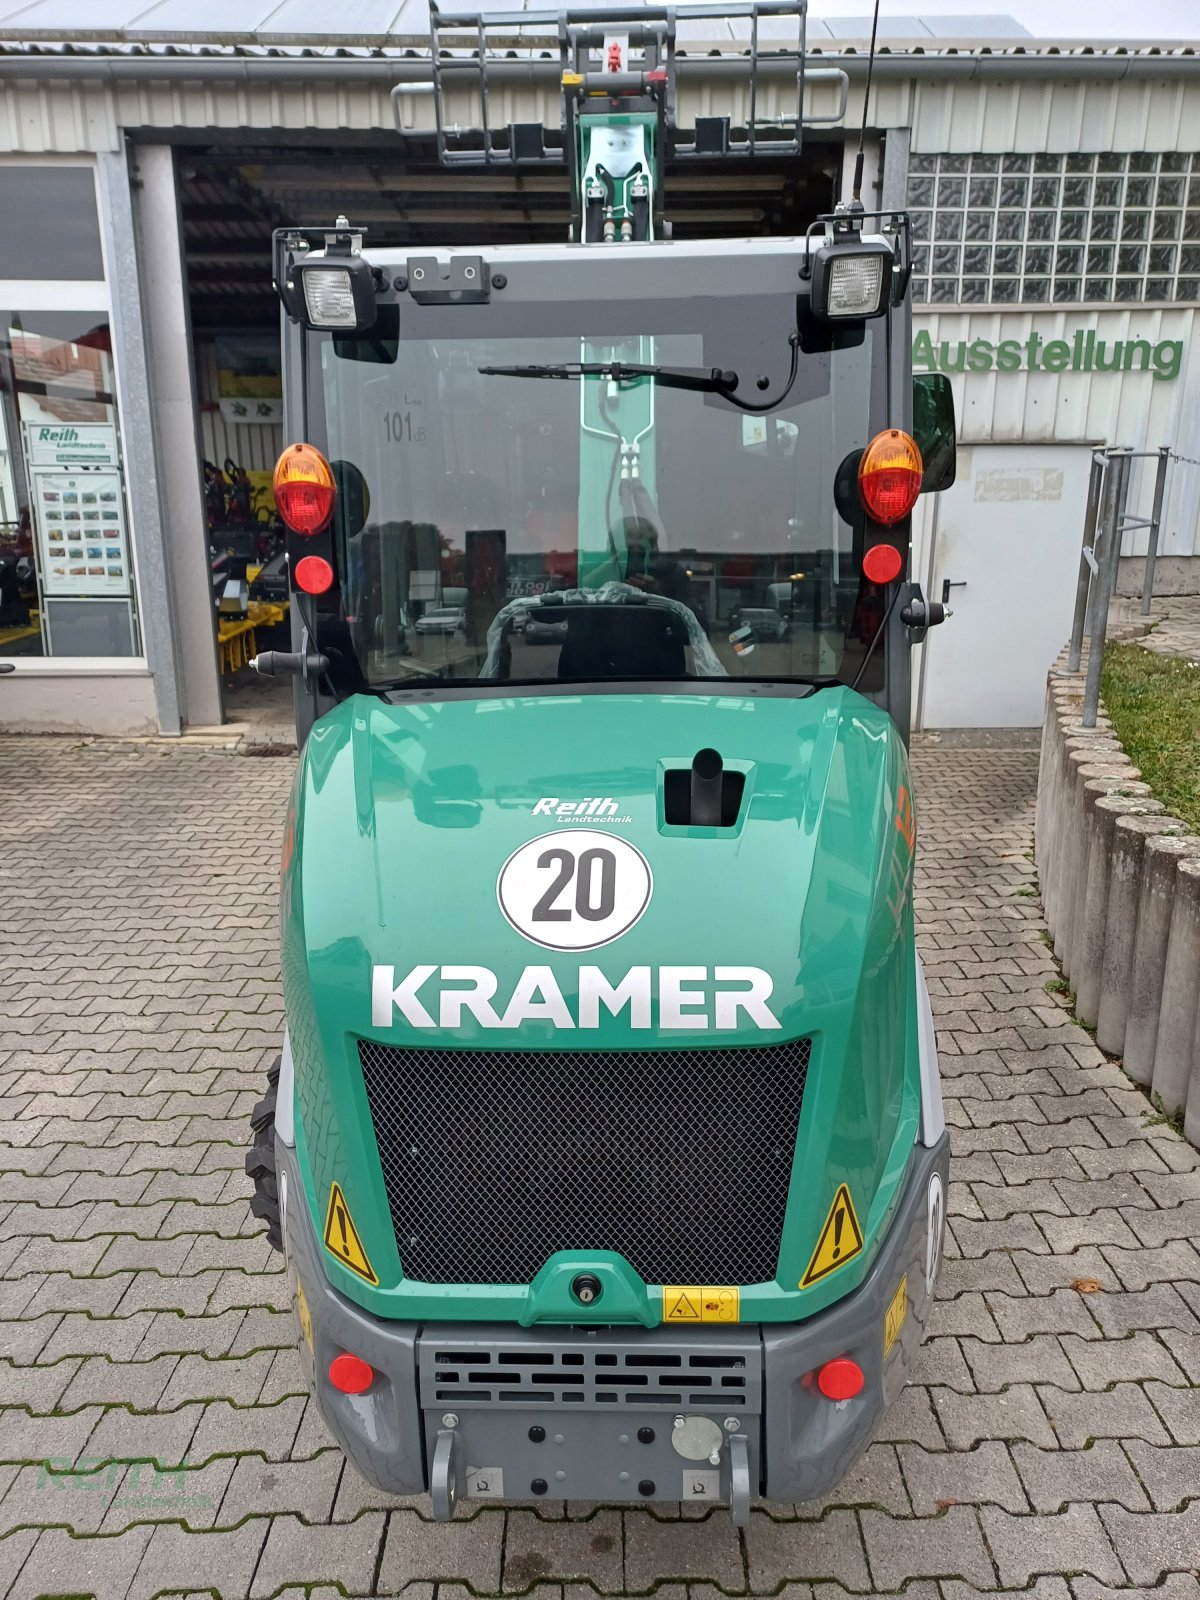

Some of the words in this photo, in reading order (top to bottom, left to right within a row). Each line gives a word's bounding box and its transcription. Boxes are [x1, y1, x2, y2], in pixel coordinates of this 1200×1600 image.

[911, 329, 1183, 381] Ausstellung
[39, 428, 79, 441] Reith
[383, 411, 412, 442] 101
[531, 797, 619, 816] Reith
[557, 815, 632, 823] Landtechnik
[532, 848, 616, 921] 20
[372, 965, 782, 1029] KRAMER
